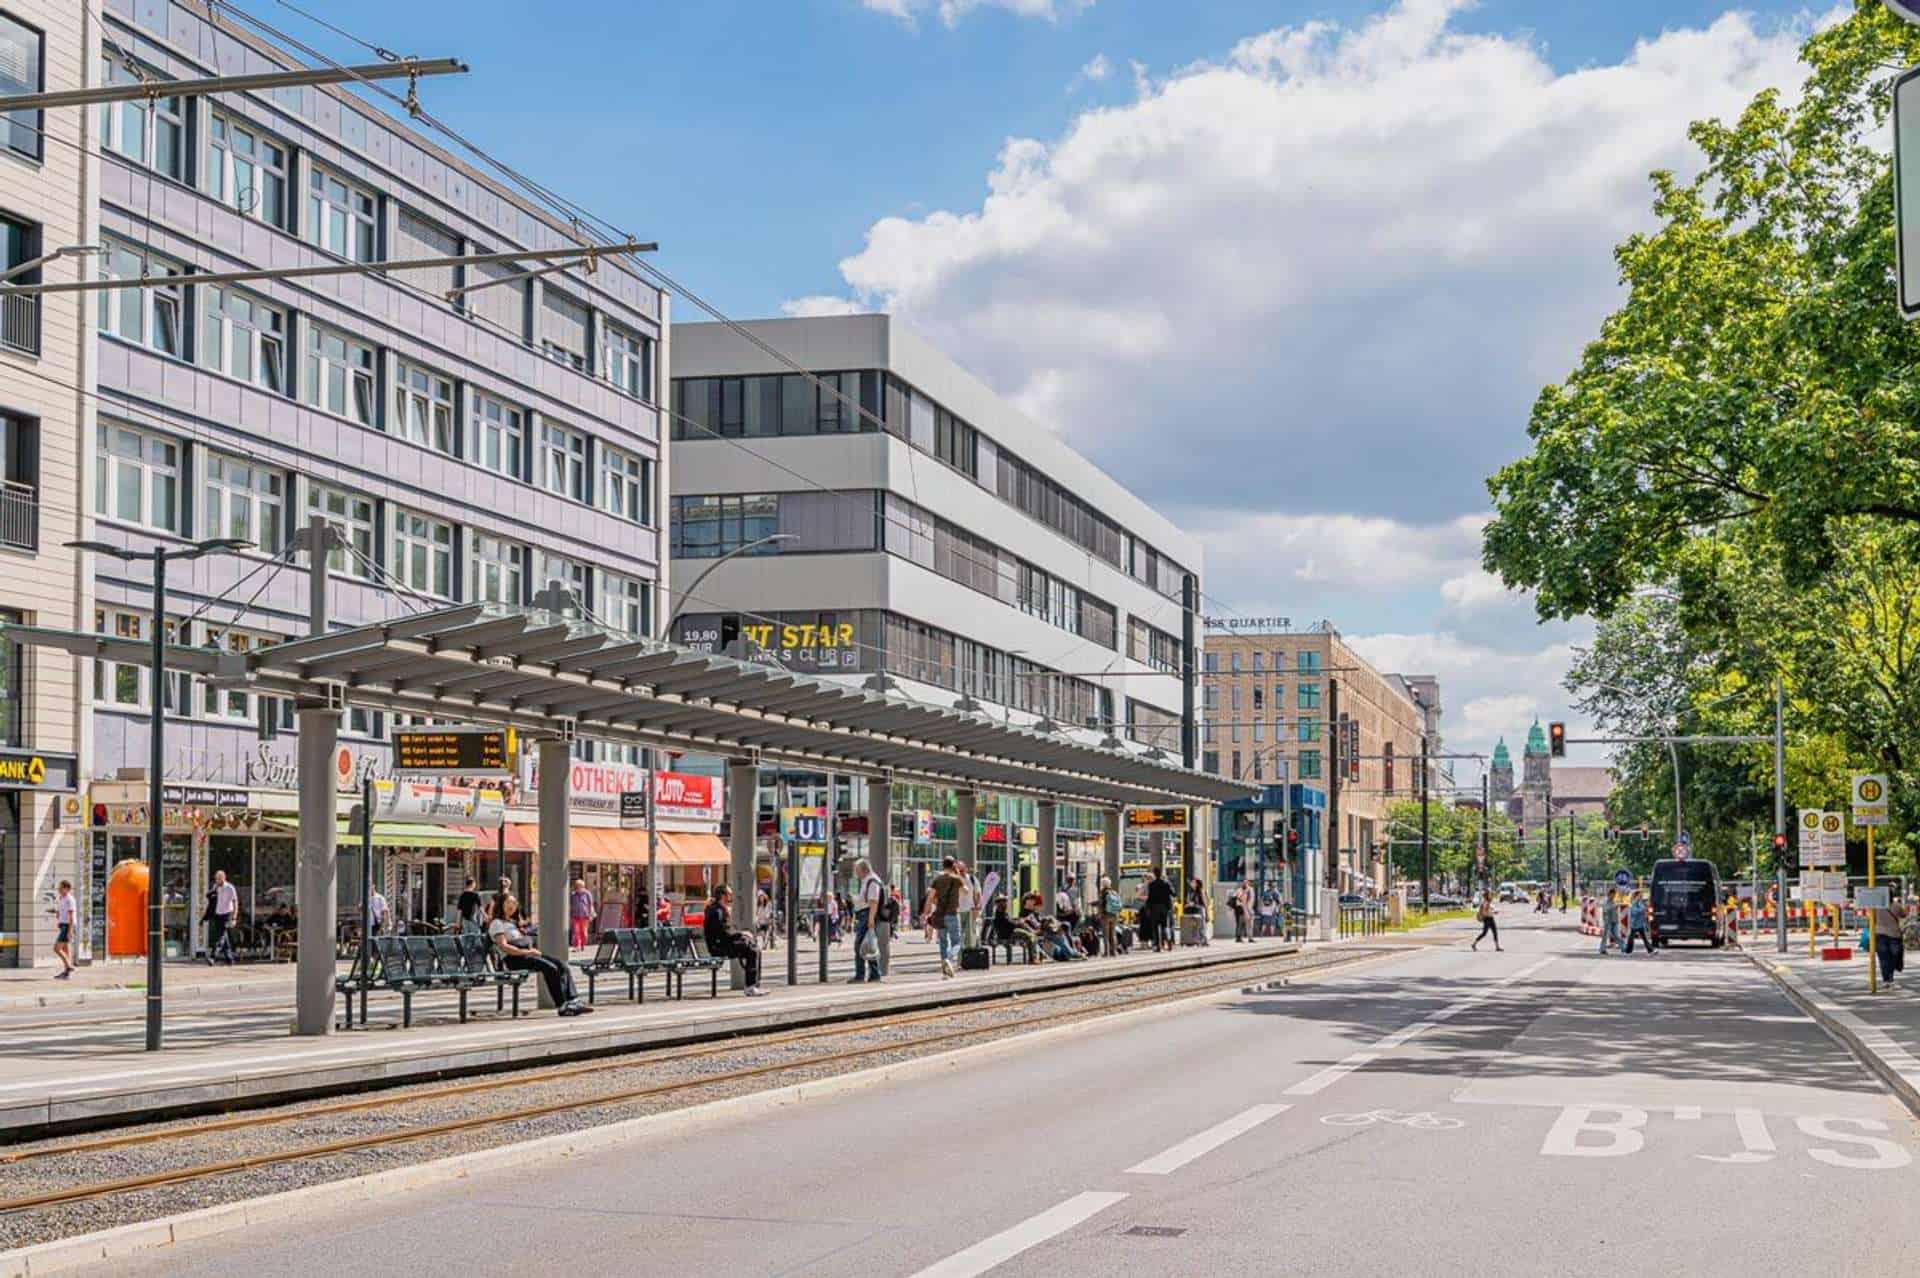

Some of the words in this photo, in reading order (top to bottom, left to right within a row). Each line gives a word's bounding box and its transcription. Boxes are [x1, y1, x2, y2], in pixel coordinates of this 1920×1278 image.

[1230, 617, 1291, 628] QUARTIER
[781, 624, 853, 648] STAR
[800, 648, 837, 662] CLUB
[572, 766, 635, 794] OTHEKE
[799, 819, 814, 839] U
